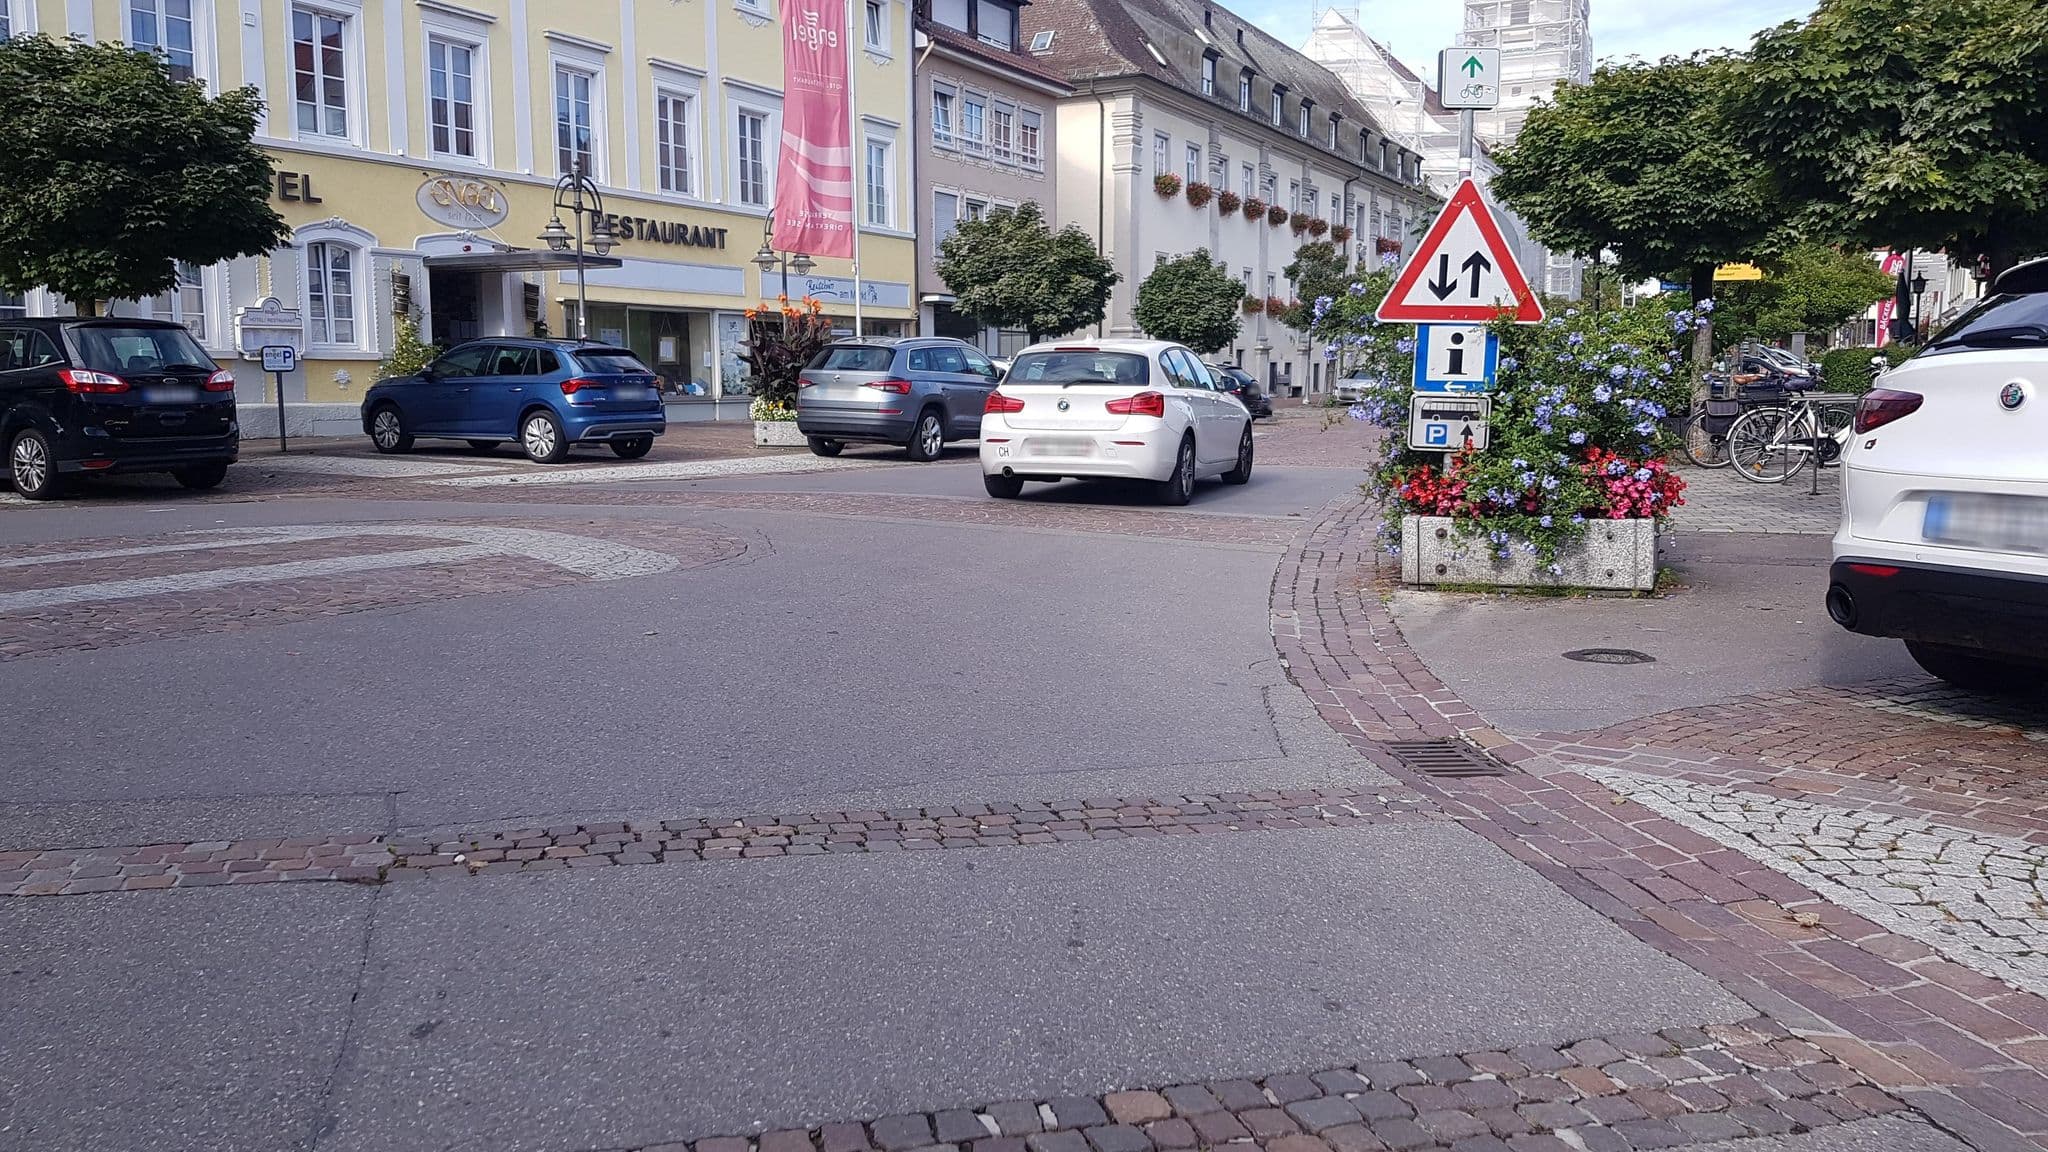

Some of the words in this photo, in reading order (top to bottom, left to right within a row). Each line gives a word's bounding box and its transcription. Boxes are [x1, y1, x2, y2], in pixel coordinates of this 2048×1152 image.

[590, 209, 728, 249] RESTAURANT
[282, 350, 292, 364] P
[1428, 426, 1446, 443] P
[998, 446, 1010, 457] CH
